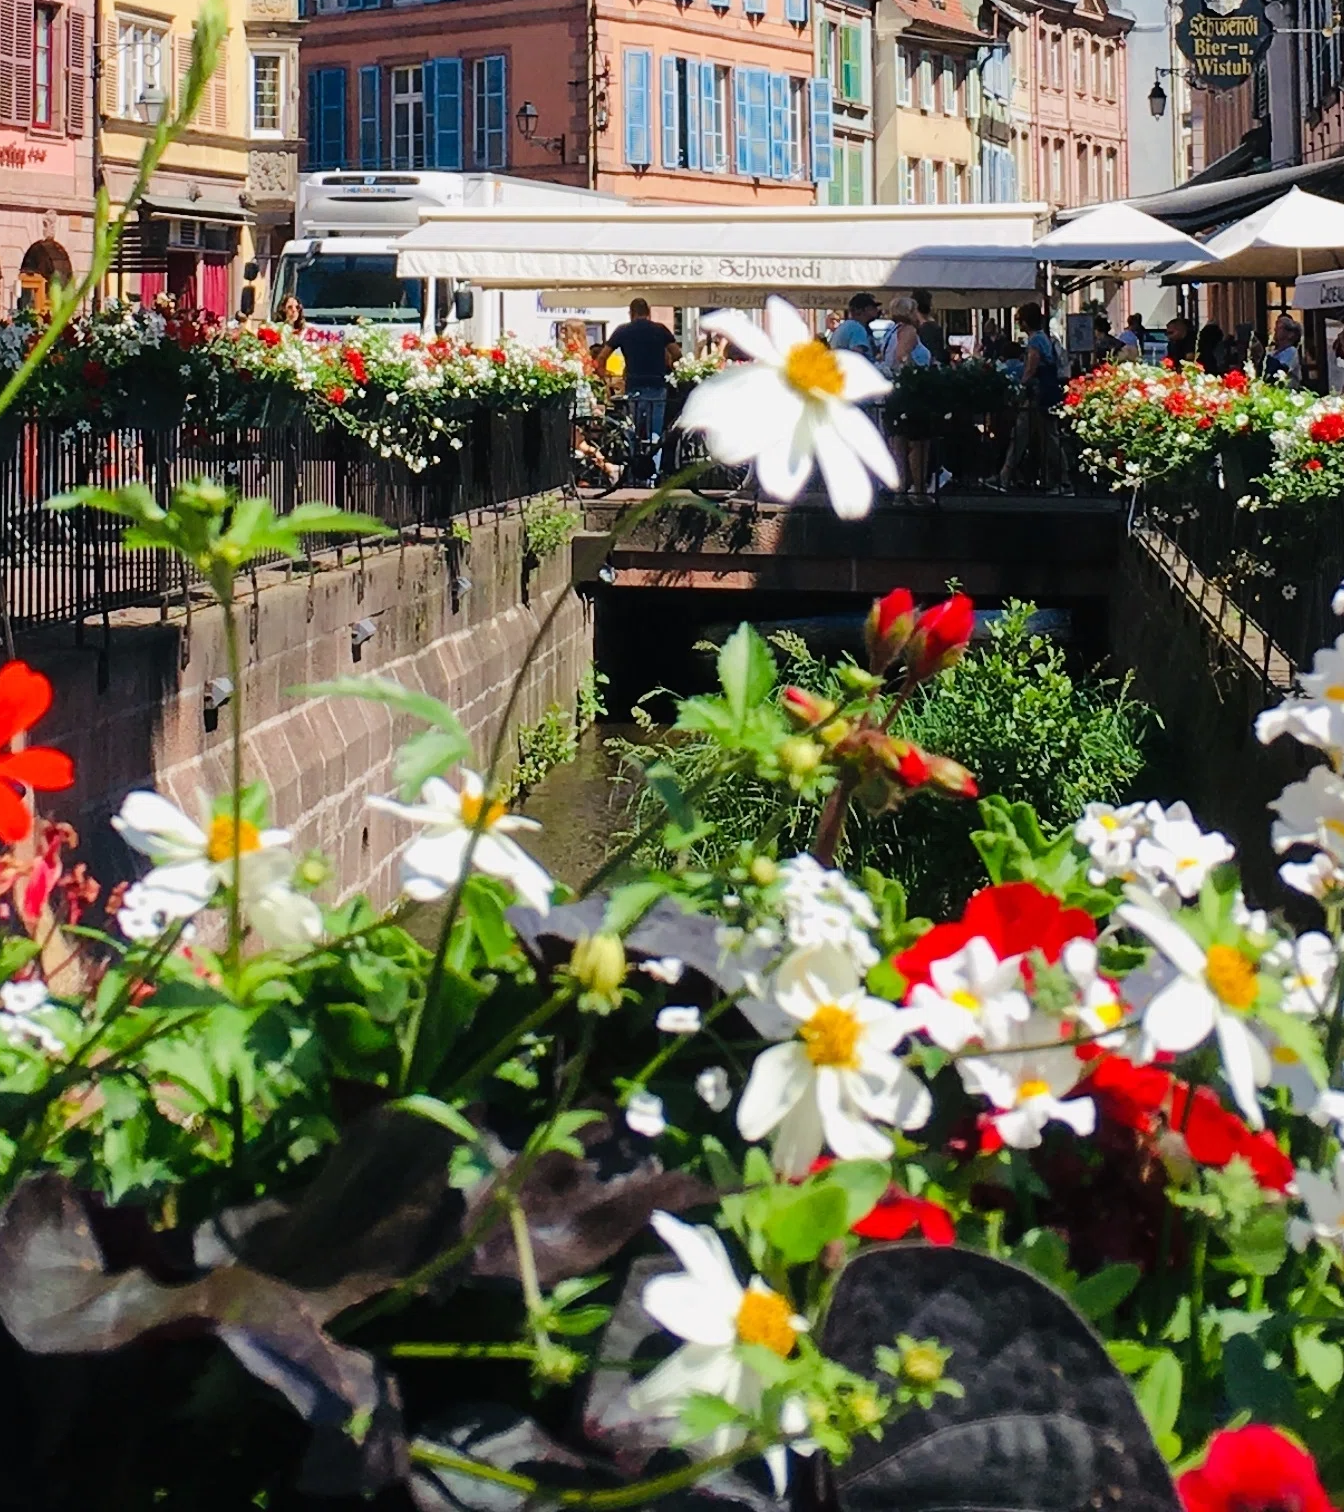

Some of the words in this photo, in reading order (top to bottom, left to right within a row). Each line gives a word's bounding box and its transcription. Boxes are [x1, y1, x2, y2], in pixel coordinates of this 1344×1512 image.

[1188, 13, 1259, 38] Schwendi
[1196, 57, 1253, 76] Wistub
[612, 258, 704, 276] Brasserie
[718, 259, 821, 281] Schwendi
